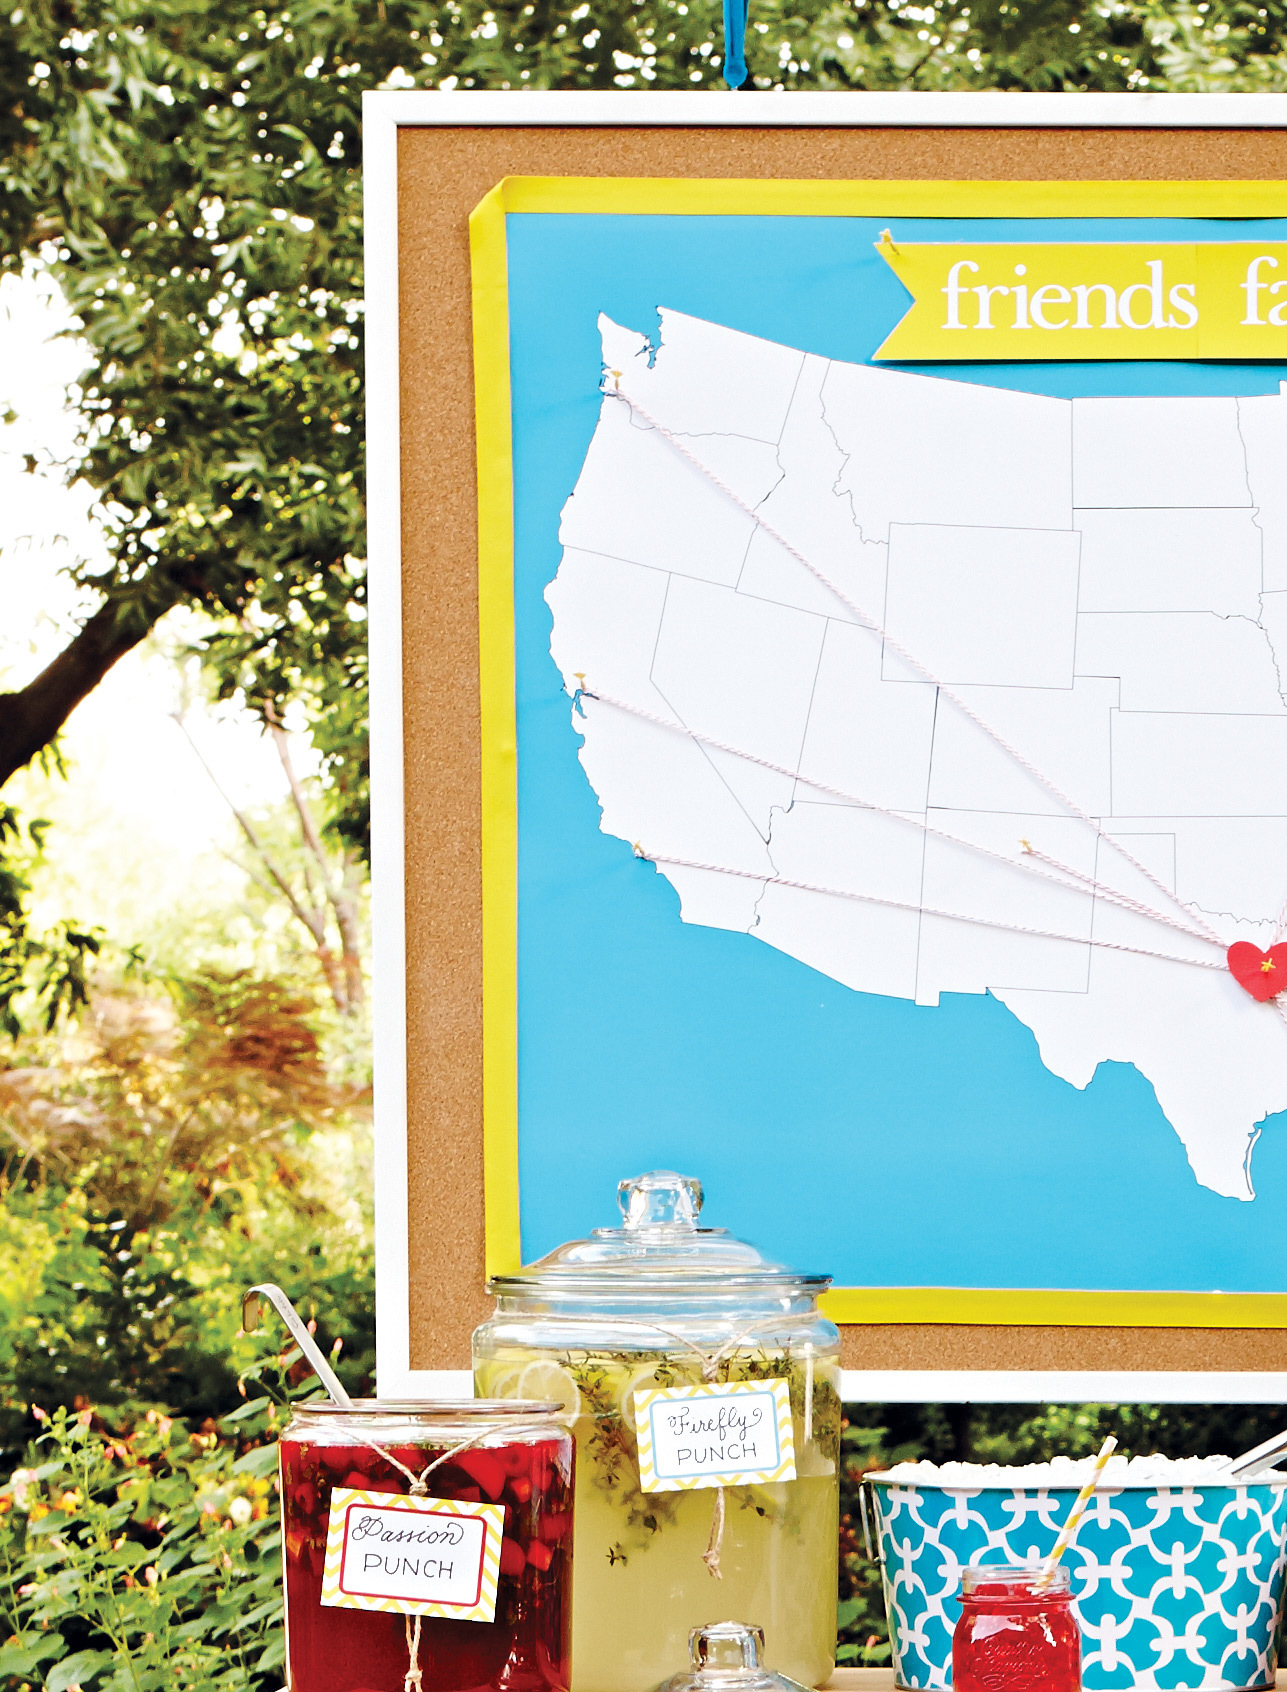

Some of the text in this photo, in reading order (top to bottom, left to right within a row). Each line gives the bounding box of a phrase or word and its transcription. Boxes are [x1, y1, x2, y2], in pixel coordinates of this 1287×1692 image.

[940, 259, 1198, 331] friends
[667, 1406, 763, 1441] Firefly
[677, 1442, 757, 1466] PUNCH
[351, 1515, 465, 1546] Passion
[363, 1553, 455, 1580] PUNCH
